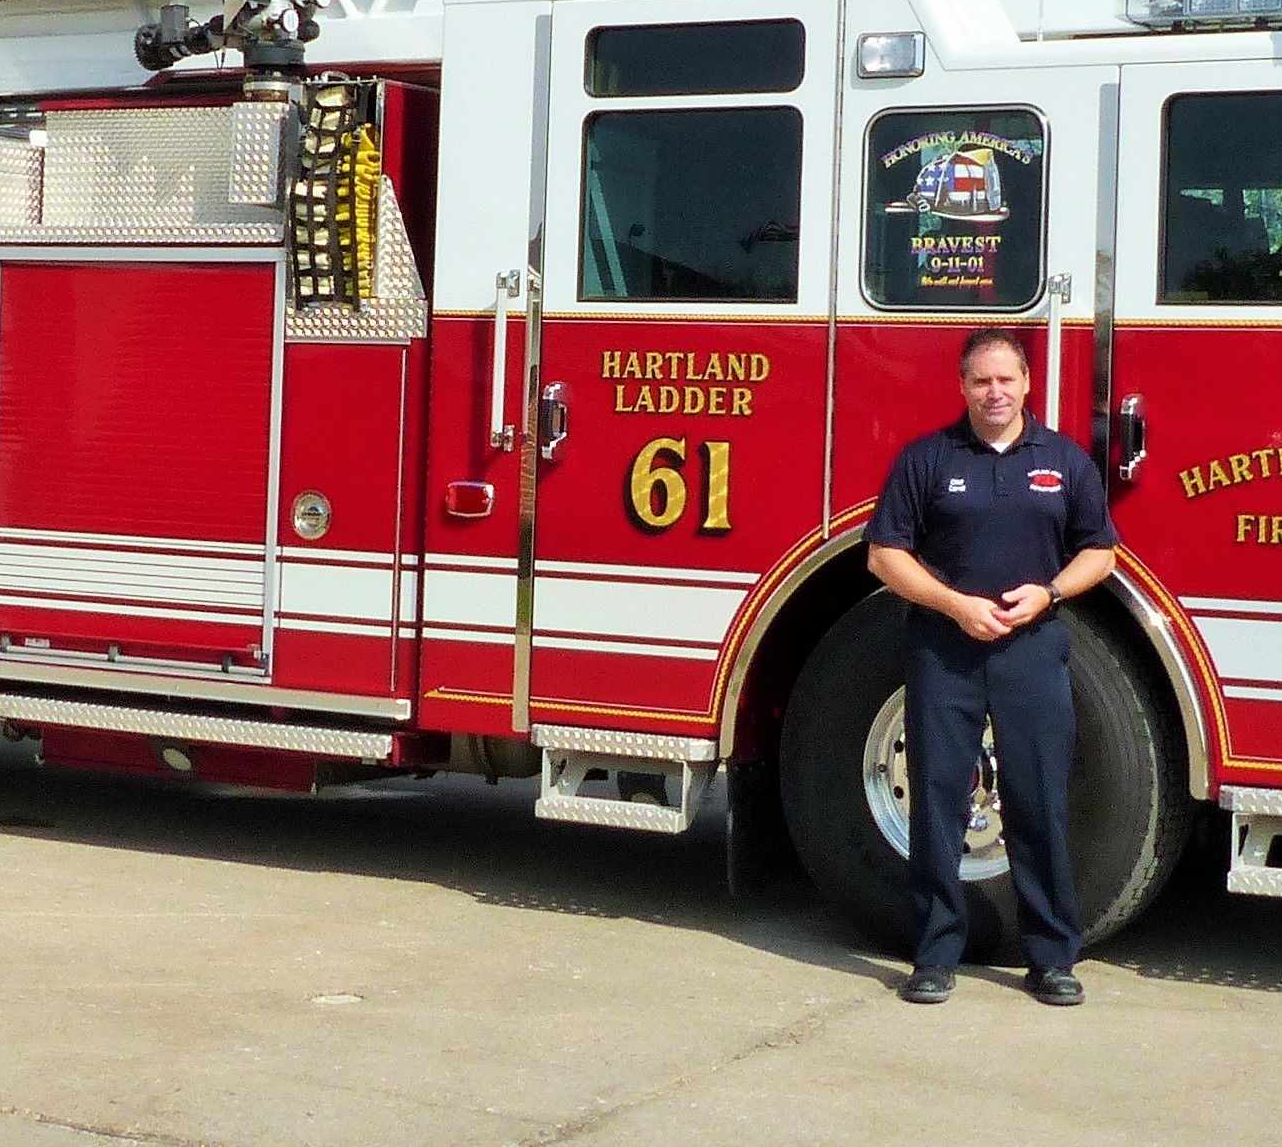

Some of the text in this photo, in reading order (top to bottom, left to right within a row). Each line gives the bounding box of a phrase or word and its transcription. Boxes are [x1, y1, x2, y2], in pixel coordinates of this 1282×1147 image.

[880, 130, 957, 168] HONORING
[910, 236, 1001, 254] BRAVEST
[930, 256, 985, 273] 9-11-01
[602, 351, 770, 381] HARTLAND
[615, 385, 753, 415] LADDER
[631, 437, 732, 528] 61
